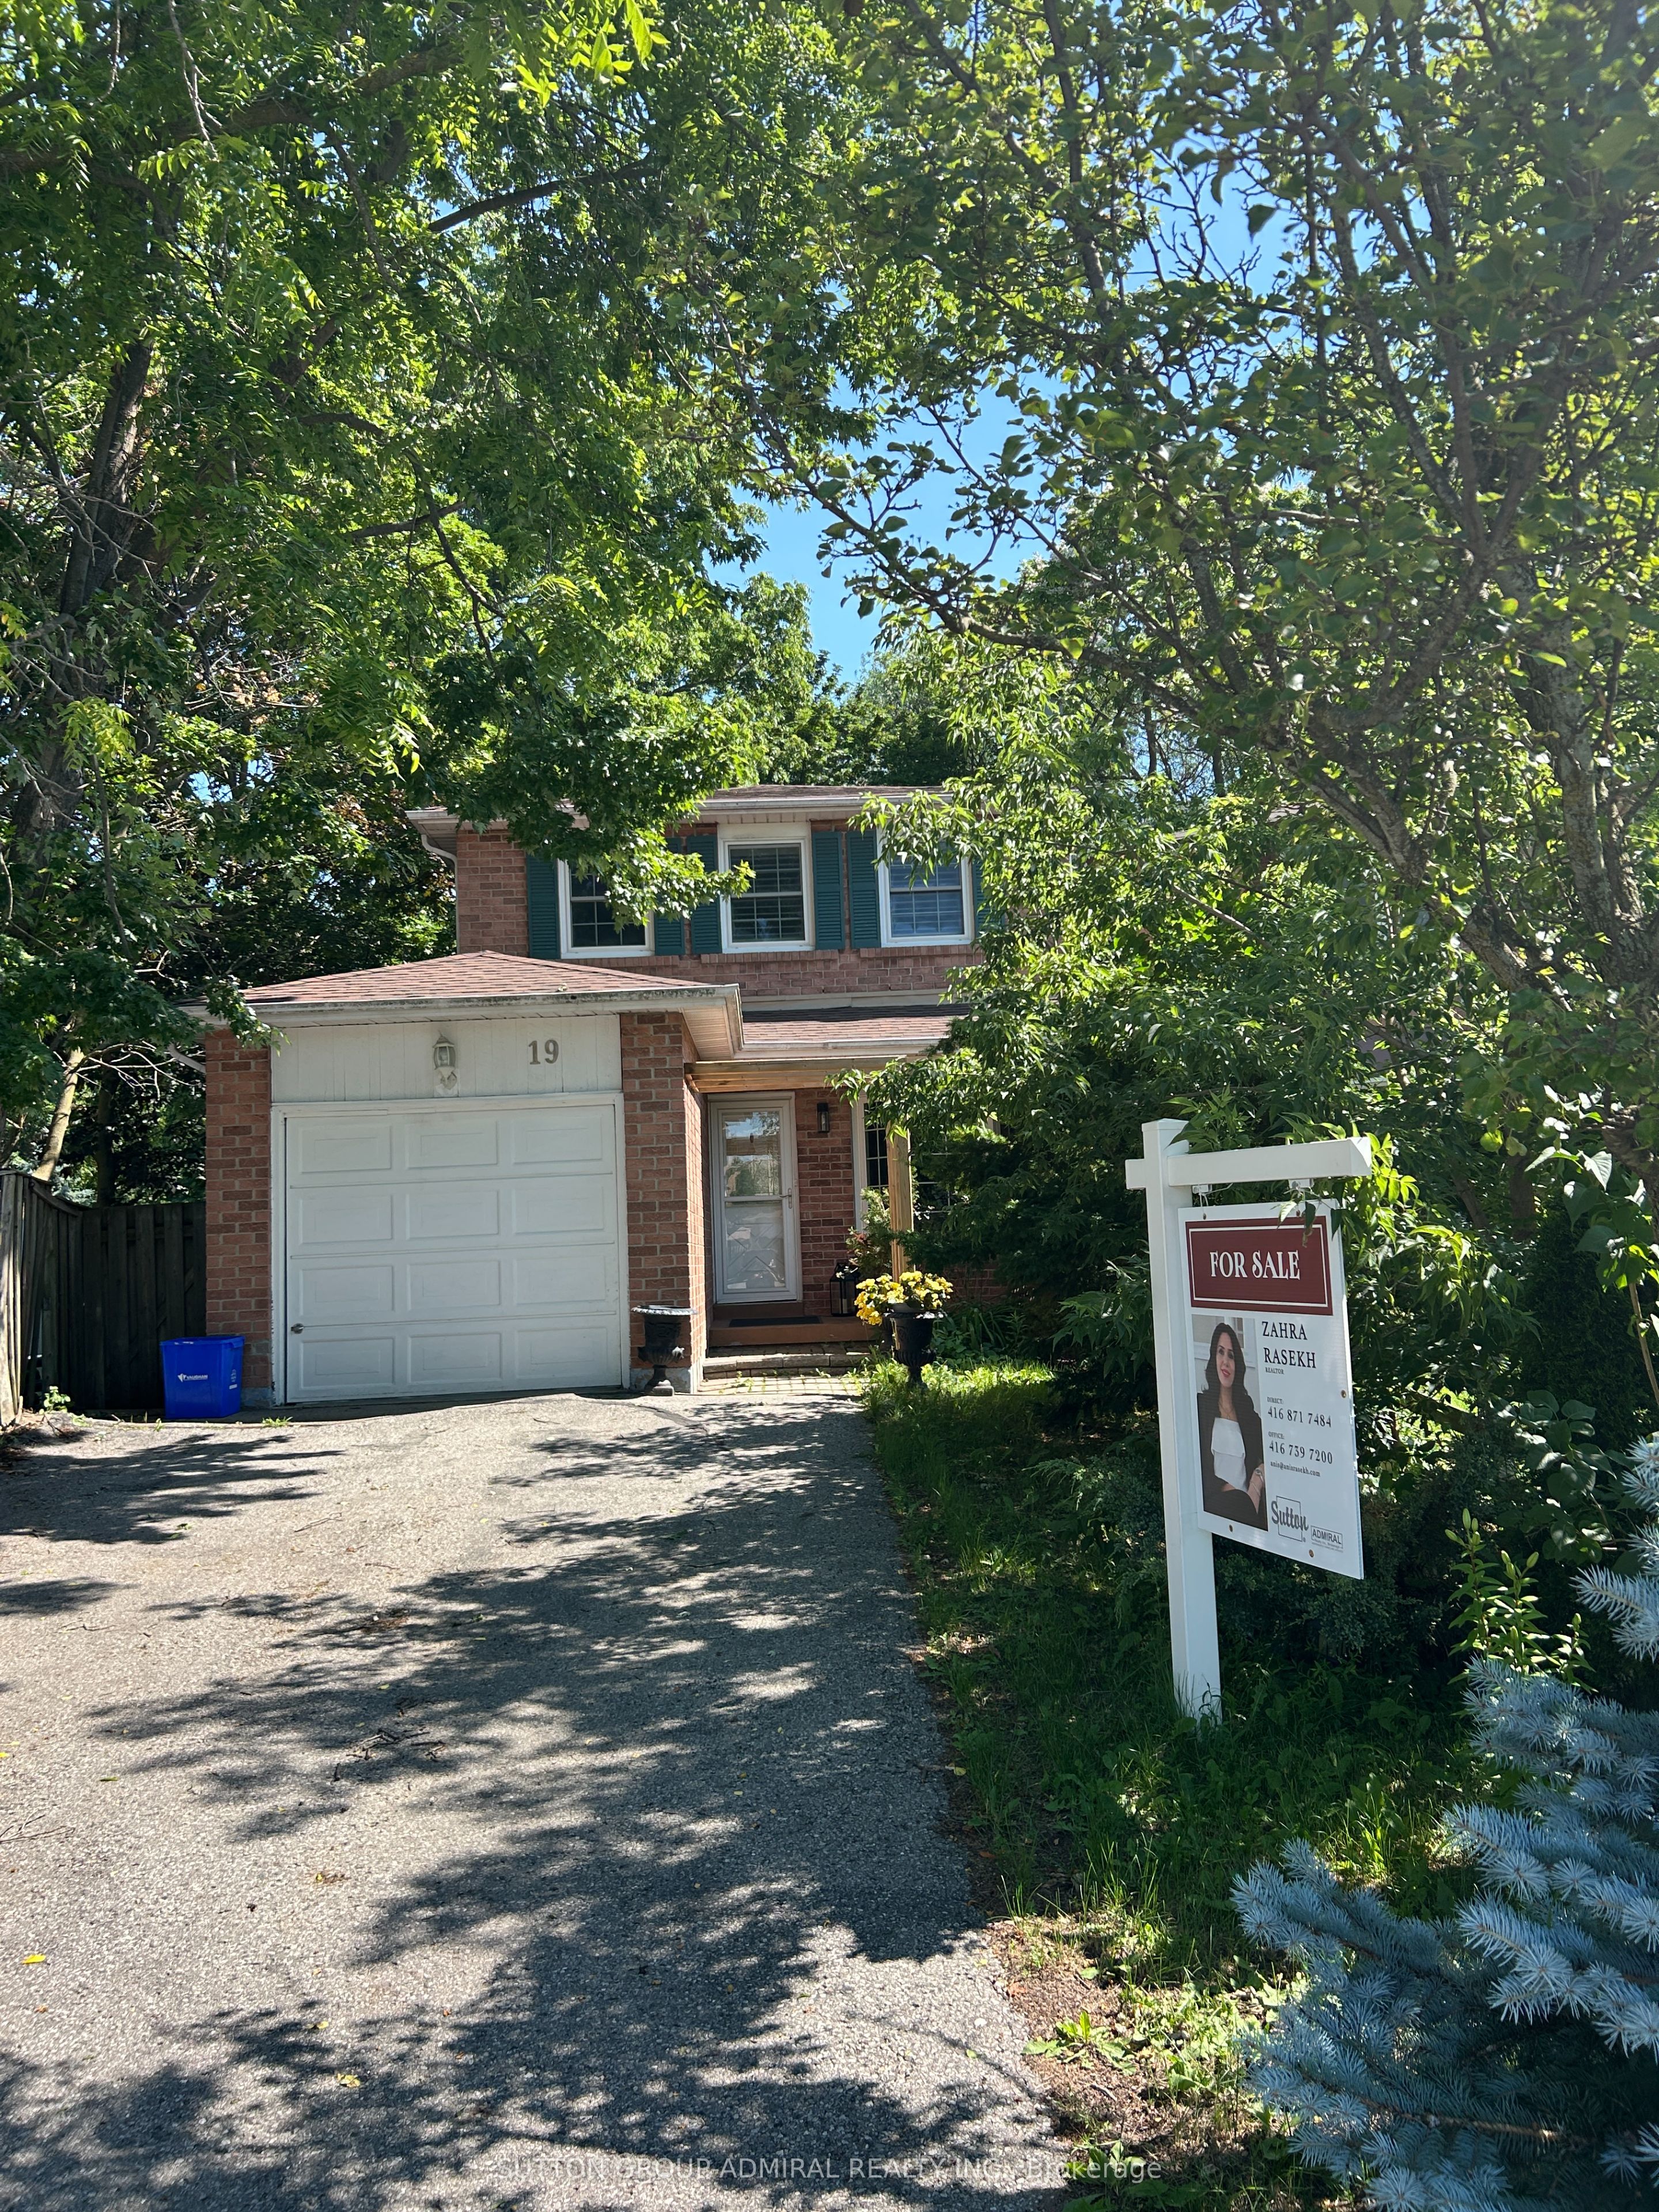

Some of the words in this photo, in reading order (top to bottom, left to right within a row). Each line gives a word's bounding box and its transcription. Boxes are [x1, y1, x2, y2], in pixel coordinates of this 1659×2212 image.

[528, 1039, 559, 1065] 19
[1210, 1251, 1247, 1278] FOR
[1252, 1250, 1300, 1280] SALE
[1262, 1321, 1307, 1340] ZAHRA
[1263, 1347, 1316, 1368] RASEKH
[1268, 1406, 1283, 1419] 416
[1287, 1409, 1303, 1423] 871
[1308, 1413, 1331, 1427] 7484
[1269, 1440, 1285, 1454] 416
[1289, 1444, 1305, 1458] 739
[1309, 1449, 1332, 1464] 7200
[1271, 1501, 1309, 1532] Sutton
[1312, 1528, 1342, 1545] ADMIRAL
